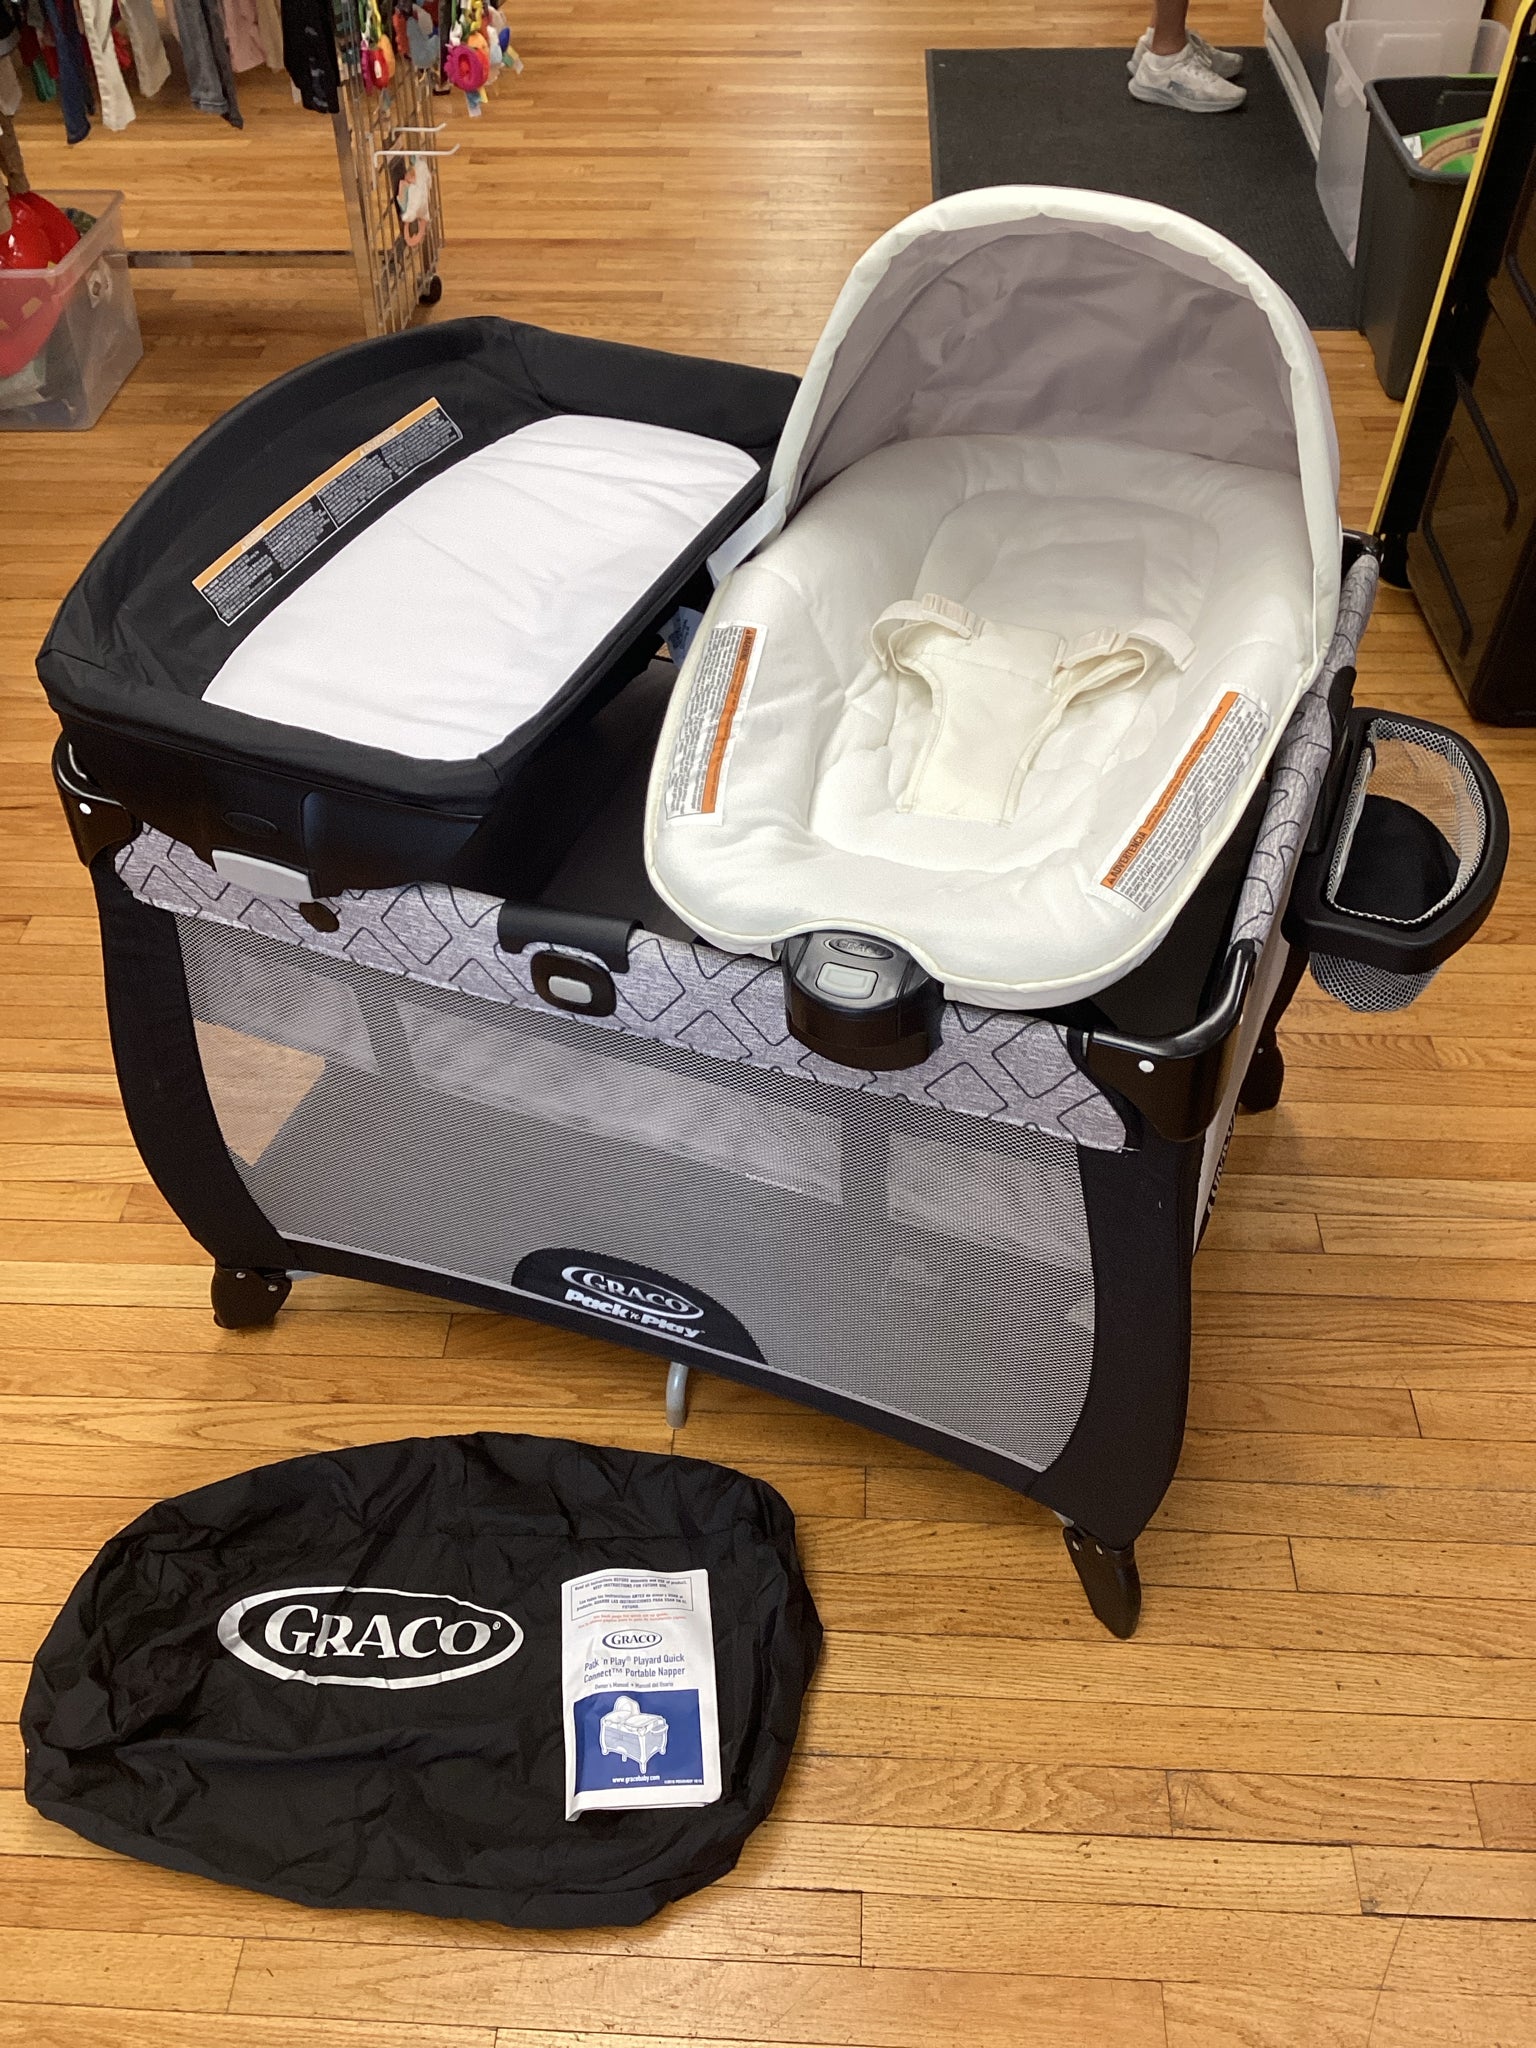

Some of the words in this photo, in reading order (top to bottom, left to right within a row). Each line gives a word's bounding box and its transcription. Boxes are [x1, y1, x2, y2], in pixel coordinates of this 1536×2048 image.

[1110, 832, 1148, 877] ADVERTENCIA
[582, 1272, 689, 1312] GRACO
[564, 1288, 628, 1319] Pack
[640, 1314, 701, 1338] Play
[611, 1634, 657, 1645] GRACO
[584, 1658, 599, 1671] Pack
[633, 1654, 661, 1667] Playard
[663, 1653, 685, 1663] Quick
[625, 1667, 656, 1678] Portable
[658, 1667, 686, 1679] Napper
